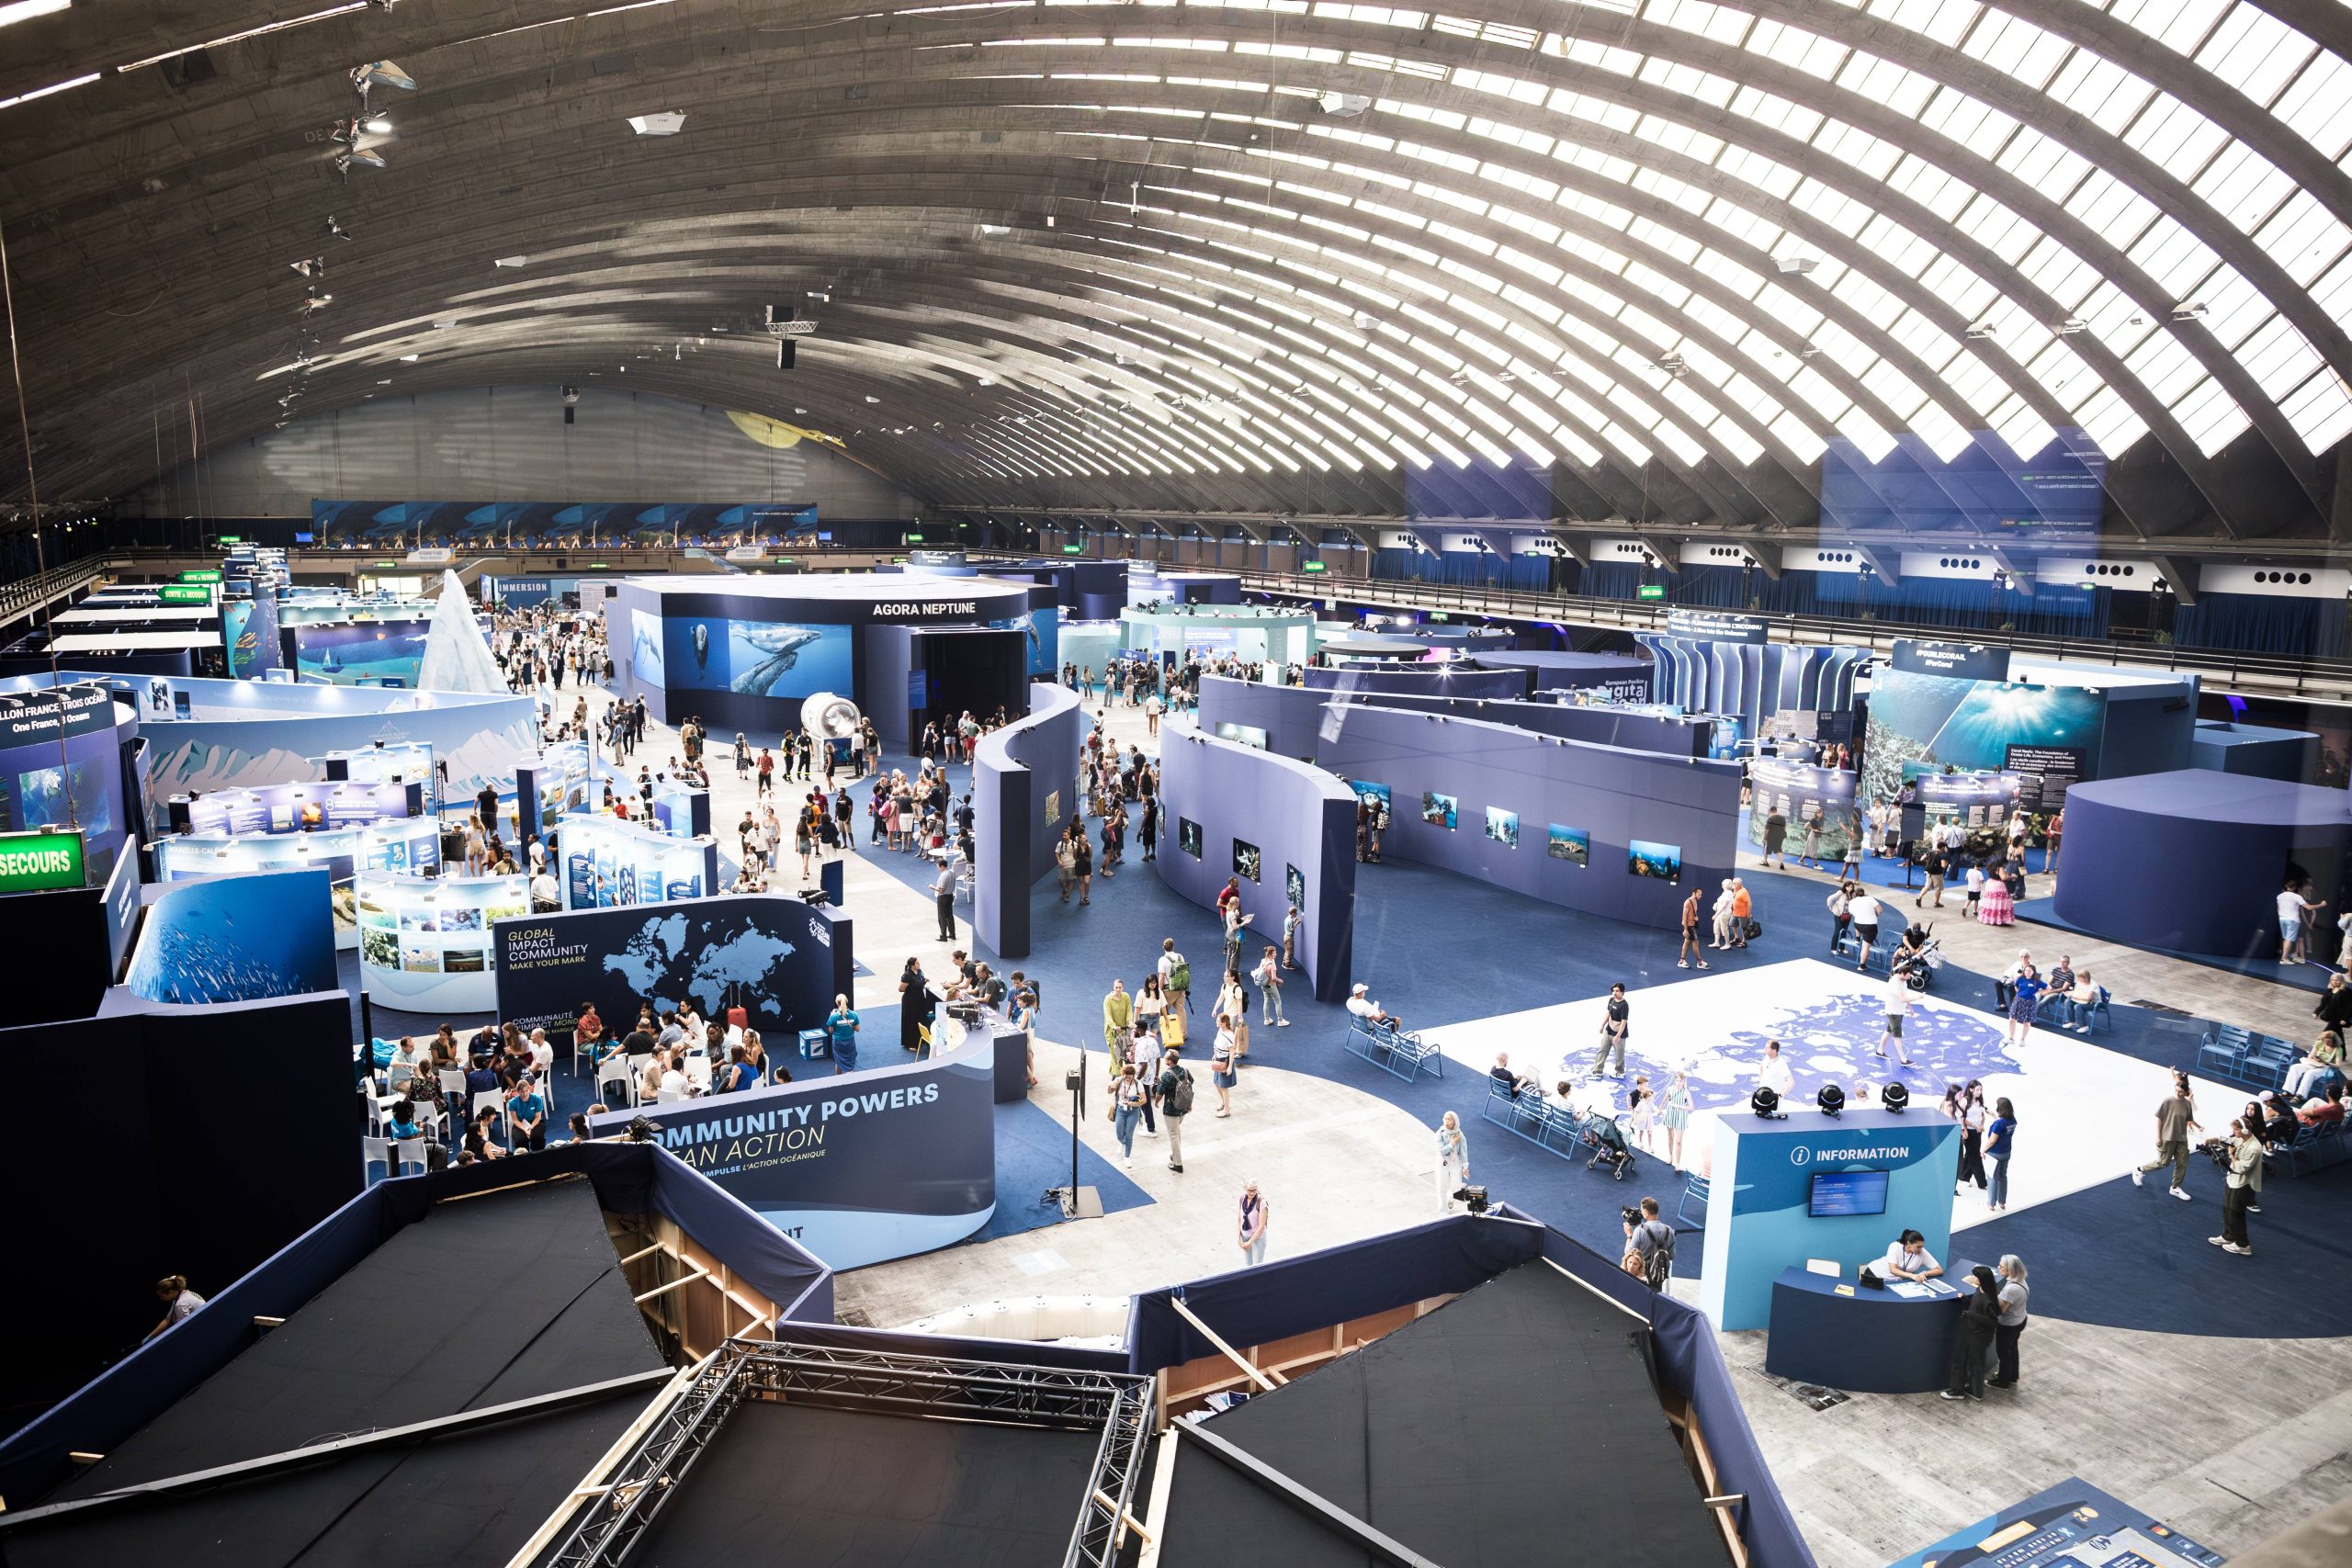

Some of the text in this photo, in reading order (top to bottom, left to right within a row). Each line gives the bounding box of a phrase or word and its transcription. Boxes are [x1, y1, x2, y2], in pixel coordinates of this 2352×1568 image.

[499, 581, 548, 593] IMMERSION
[873, 602, 976, 615] AGORA NEPTUNE
[62, 698, 84, 710] TROIS
[13, 723, 30, 733] One
[31, 718, 60, 730] France,
[67, 712, 90, 723] Oceans
[0, 850, 71, 876] SECOURS
[508, 928, 555, 942] GLOBAL
[508, 937, 555, 952] IMPACT
[509, 944, 588, 962] COMMUNITY
[509, 955, 586, 971] MAKE YOUR MARK
[513, 1010, 574, 1026] COMMUNAUTÉ
[554, 1018, 580, 1027] MOND
[650, 1083, 939, 1148] OMMUNITY POWERS
[725, 1125, 826, 1162] ACTION
[1816, 1146, 1909, 1162] INFORMATION
[703, 1149, 826, 1178] IMPULSE L'ACTION OCÉANIQUE
